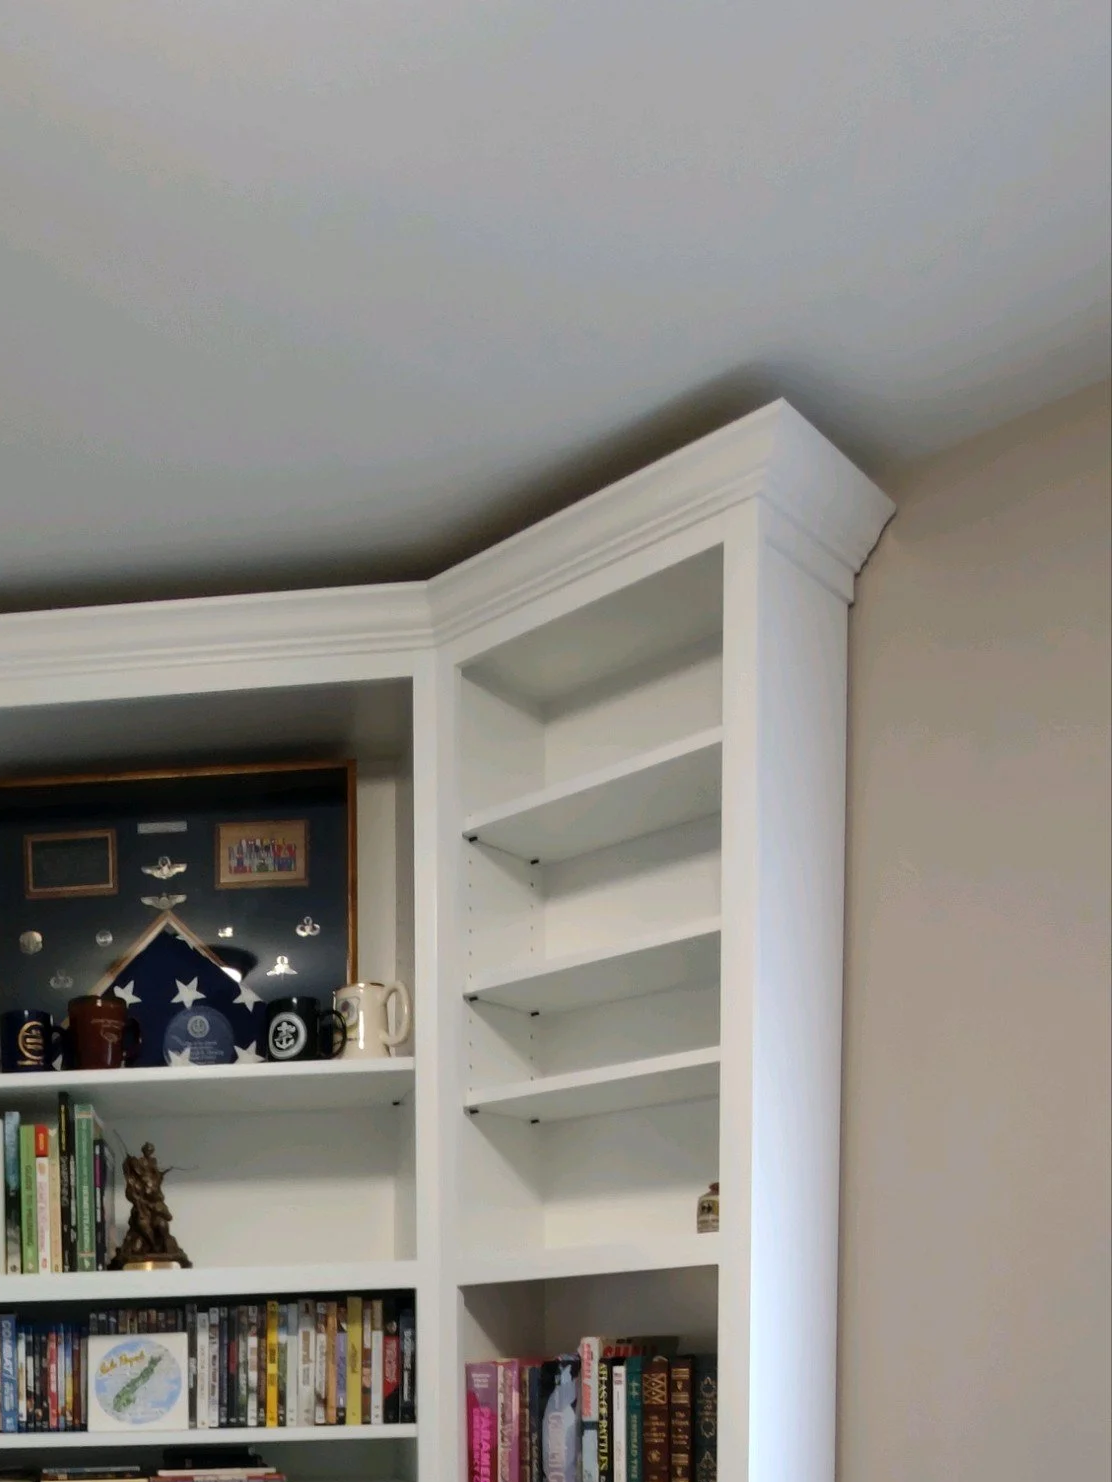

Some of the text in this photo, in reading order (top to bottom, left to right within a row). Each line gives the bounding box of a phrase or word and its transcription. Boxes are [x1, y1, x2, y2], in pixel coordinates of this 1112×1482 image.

[598, 1362, 608, 1399] ATLAS
[598, 1420, 608, 1471] BATTLES
[630, 1459, 638, 1480] THE
